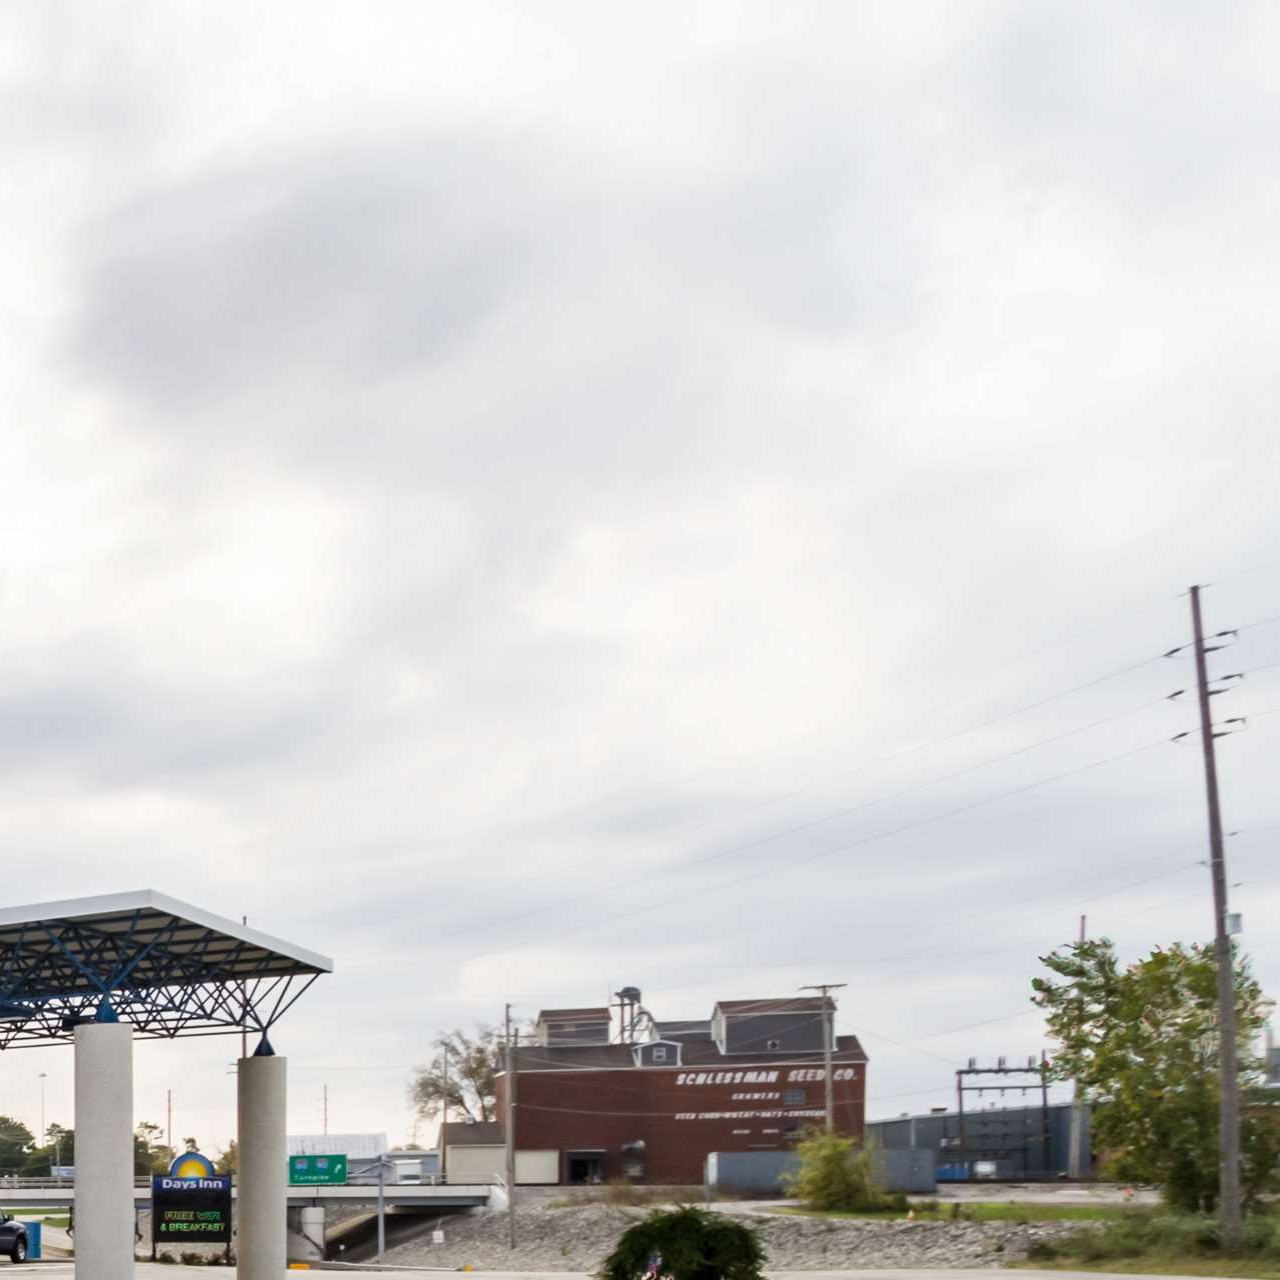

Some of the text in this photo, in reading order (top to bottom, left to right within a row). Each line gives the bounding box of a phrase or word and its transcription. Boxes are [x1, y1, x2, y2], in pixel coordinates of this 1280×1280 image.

[676, 1067, 858, 1085] SCHLESSMAN SEED CO.
[162, 1179, 223, 1190] Days Inn
[169, 1222, 226, 1232] BREAKFAST
